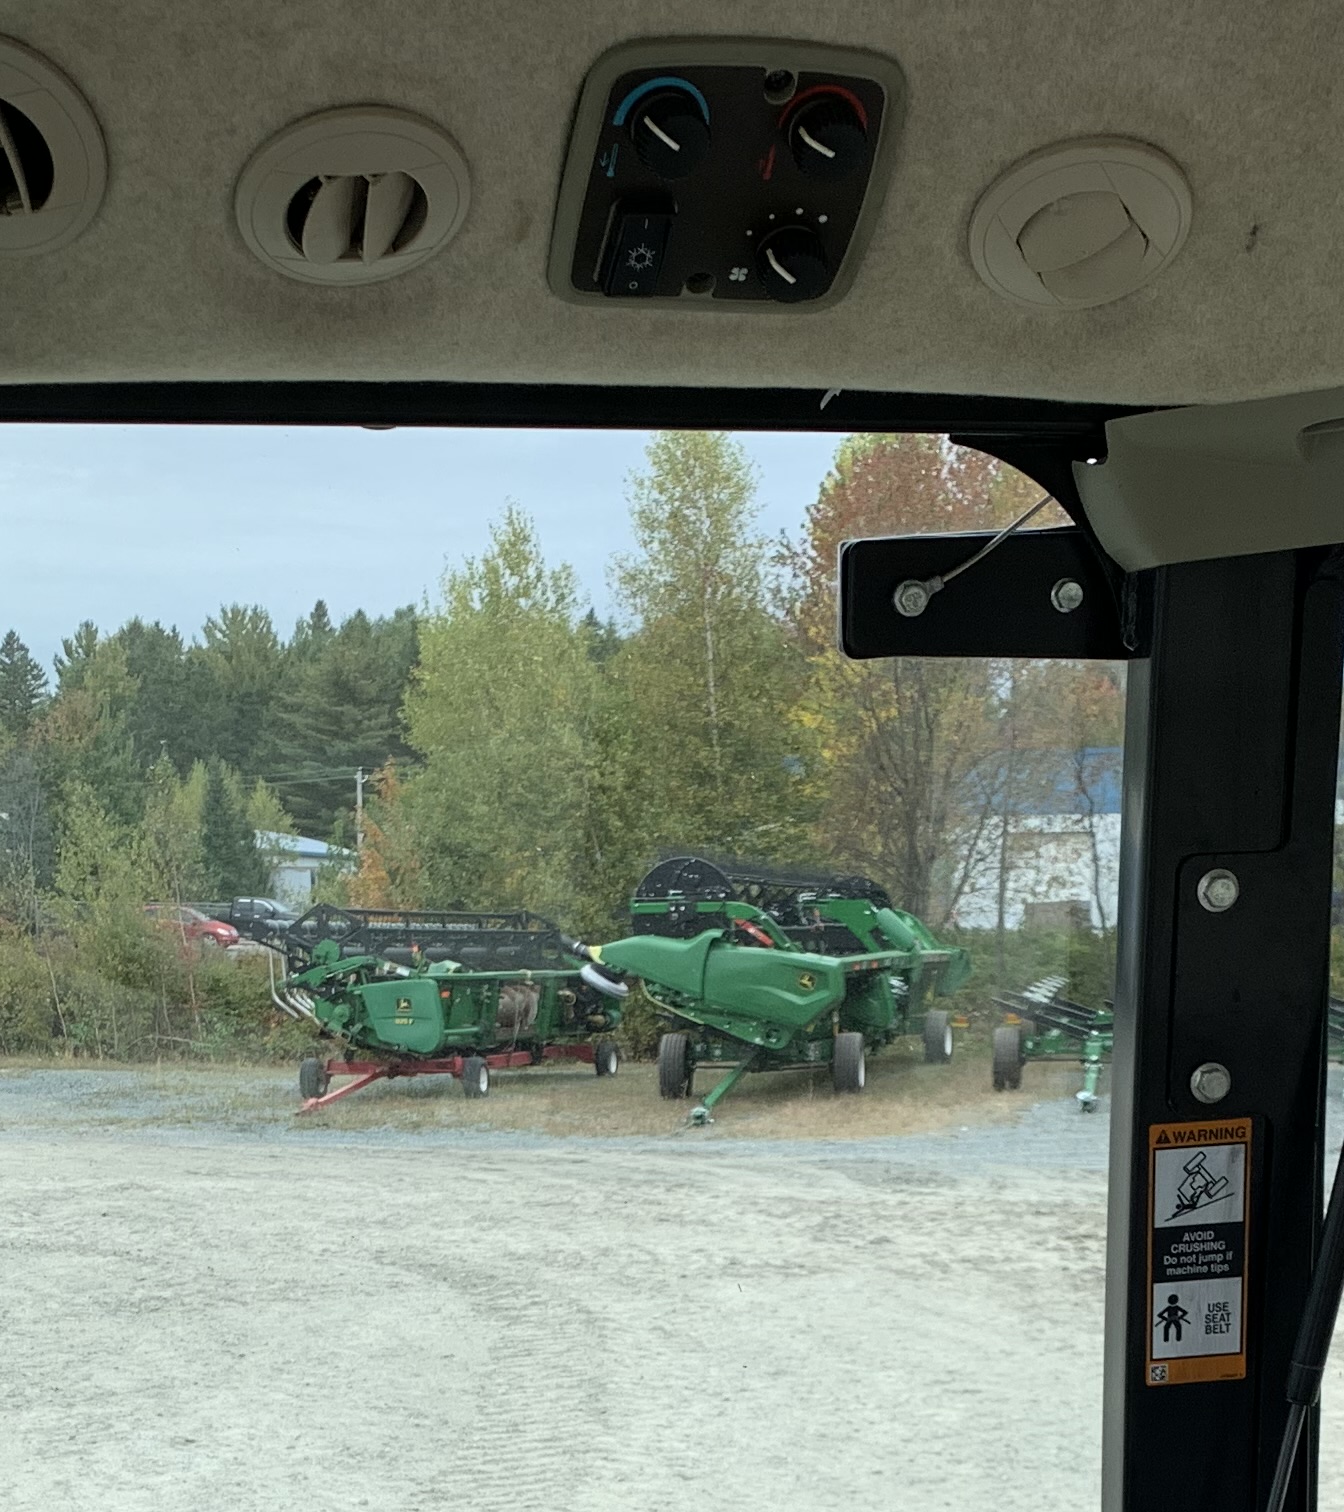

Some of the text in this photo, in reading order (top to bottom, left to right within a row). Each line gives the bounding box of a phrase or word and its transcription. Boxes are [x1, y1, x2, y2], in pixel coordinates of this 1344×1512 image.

[1173, 1126, 1247, 1143] WARNING
[1183, 1230, 1215, 1242] AVOID
[1170, 1240, 1226, 1254] CRUSHING
[1163, 1250, 1233, 1265] Do not jump if
[1166, 1263, 1230, 1276] machine tips
[1207, 1301, 1229, 1313] USE
[1205, 1312, 1231, 1324] SEAT
[1205, 1322, 1231, 1335] BELT
